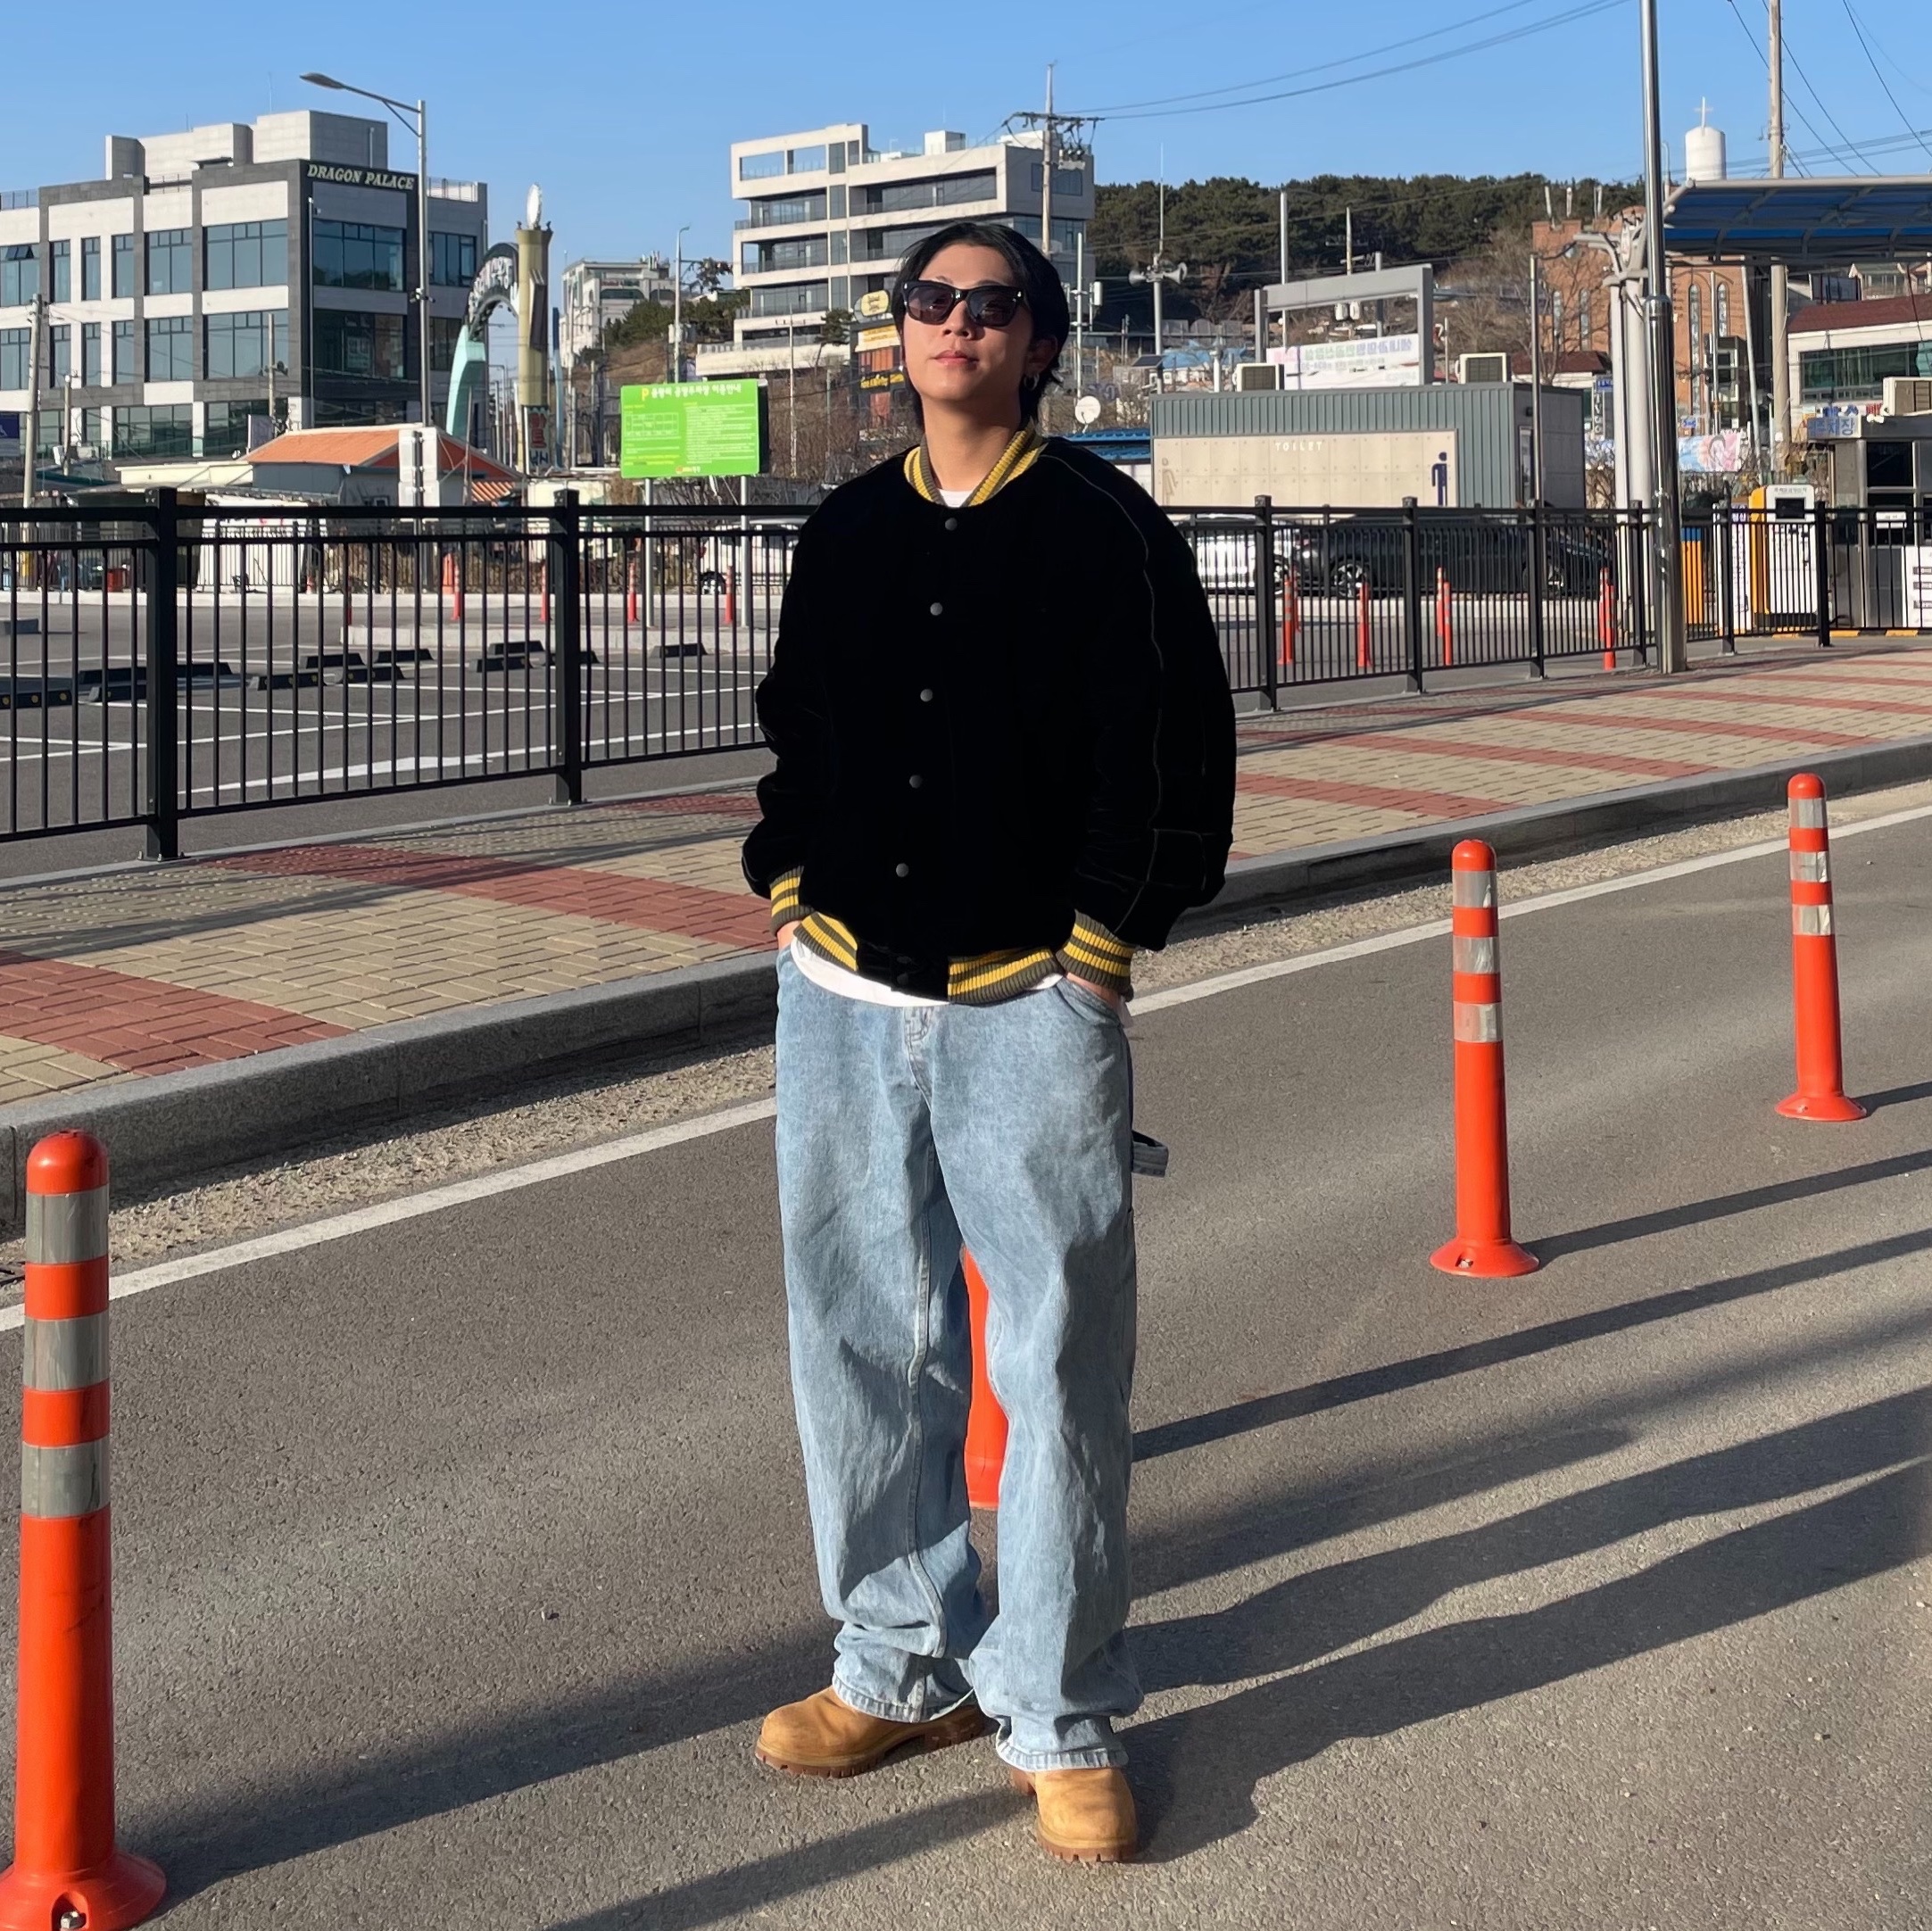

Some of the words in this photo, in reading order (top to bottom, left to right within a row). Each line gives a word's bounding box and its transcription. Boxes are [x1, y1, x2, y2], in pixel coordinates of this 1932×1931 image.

[307, 164, 362, 184] DRAGON
[364, 170, 415, 190] PALACE
[1274, 441, 1323, 452] TOILET
